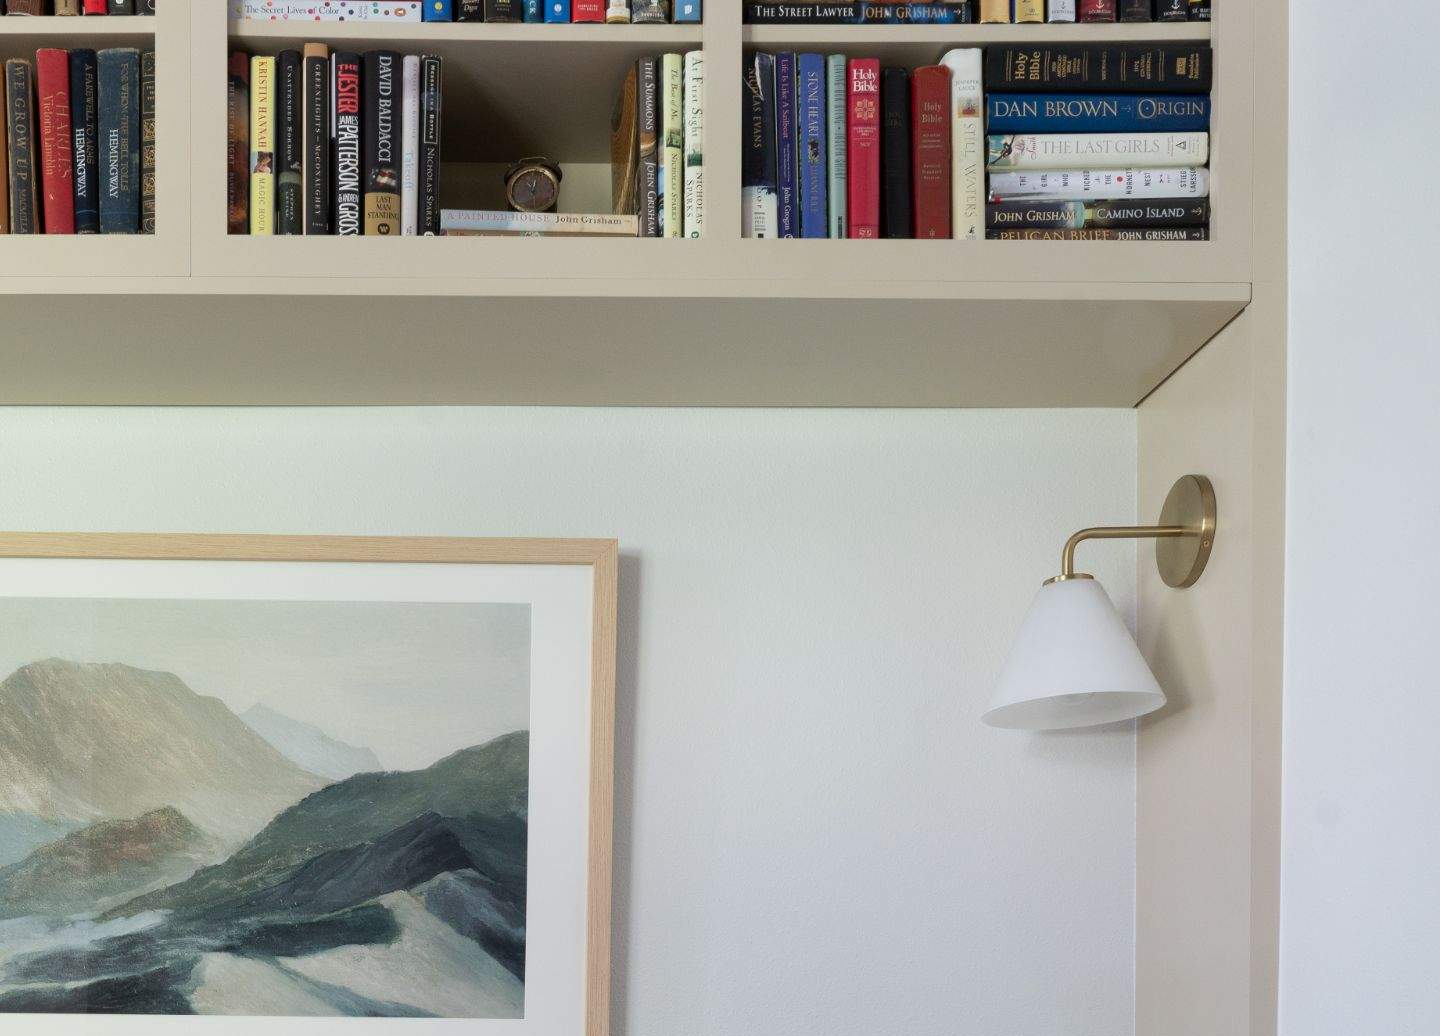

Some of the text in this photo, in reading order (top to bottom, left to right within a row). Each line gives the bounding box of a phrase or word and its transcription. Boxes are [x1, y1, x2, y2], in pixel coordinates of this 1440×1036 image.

[245, 5, 259, 14] The
[260, 5, 285, 14] Secret
[287, 5, 307, 14] Lives
[318, 6, 340, 15] Color
[860, 3, 893, 19] JOHN
[896, 3, 948, 18] GRISHAM
[645, 62, 654, 79] THE
[781, 59, 789, 72] Life
[852, 69, 877, 82] Holy
[1015, 51, 1028, 79] Holy
[1029, 51, 1041, 80] Bible
[337, 72, 359, 113] JESTER
[691, 77, 703, 103] First
[853, 81, 878, 93] Bible
[258, 61, 268, 148] KRISTIN HANNAH
[378, 56, 392, 162] DAVID BALDACCI
[807, 71, 818, 137] STONE HEART
[924, 102, 942, 112] Holy
[994, 101, 1038, 117] DAN
[1045, 100, 1117, 117] BROWN
[14, 65, 28, 180] WE GROW UP
[86, 123, 94, 136] TO
[338, 116, 359, 125] JAMES
[688, 107, 703, 137] Sight
[782, 110, 790, 139] Sailboat
[921, 114, 942, 123] Bible
[42, 95, 55, 176] Victoria Lincoln
[55, 90, 73, 179] CHARLES
[1042, 140, 1072, 154] THE
[1075, 140, 1113, 153] LAST
[1114, 139, 1160, 153] GIRLS
[75, 128, 86, 198] HEMINGWAY
[86, 138, 94, 164] ARMS
[109, 128, 119, 199] HEMINGWAY
[338, 125, 359, 191] PATTERSON
[964, 121, 977, 218] STILL WATERS
[258, 178, 266, 231] MAGIC HOUR
[783, 187, 791, 203] John
[338, 202, 359, 235] GROS
[511, 214, 549, 222] HOUSE
[555, 214, 578, 223] John
[580, 216, 622, 225] Grisham
[782, 205, 791, 230] Grogan
[994, 210, 1023, 223] JOHN
[1026, 209, 1076, 222] GRISHAM
[1000, 230, 1187, 240] PELICAN BRIEF JOHN GRISHAM
